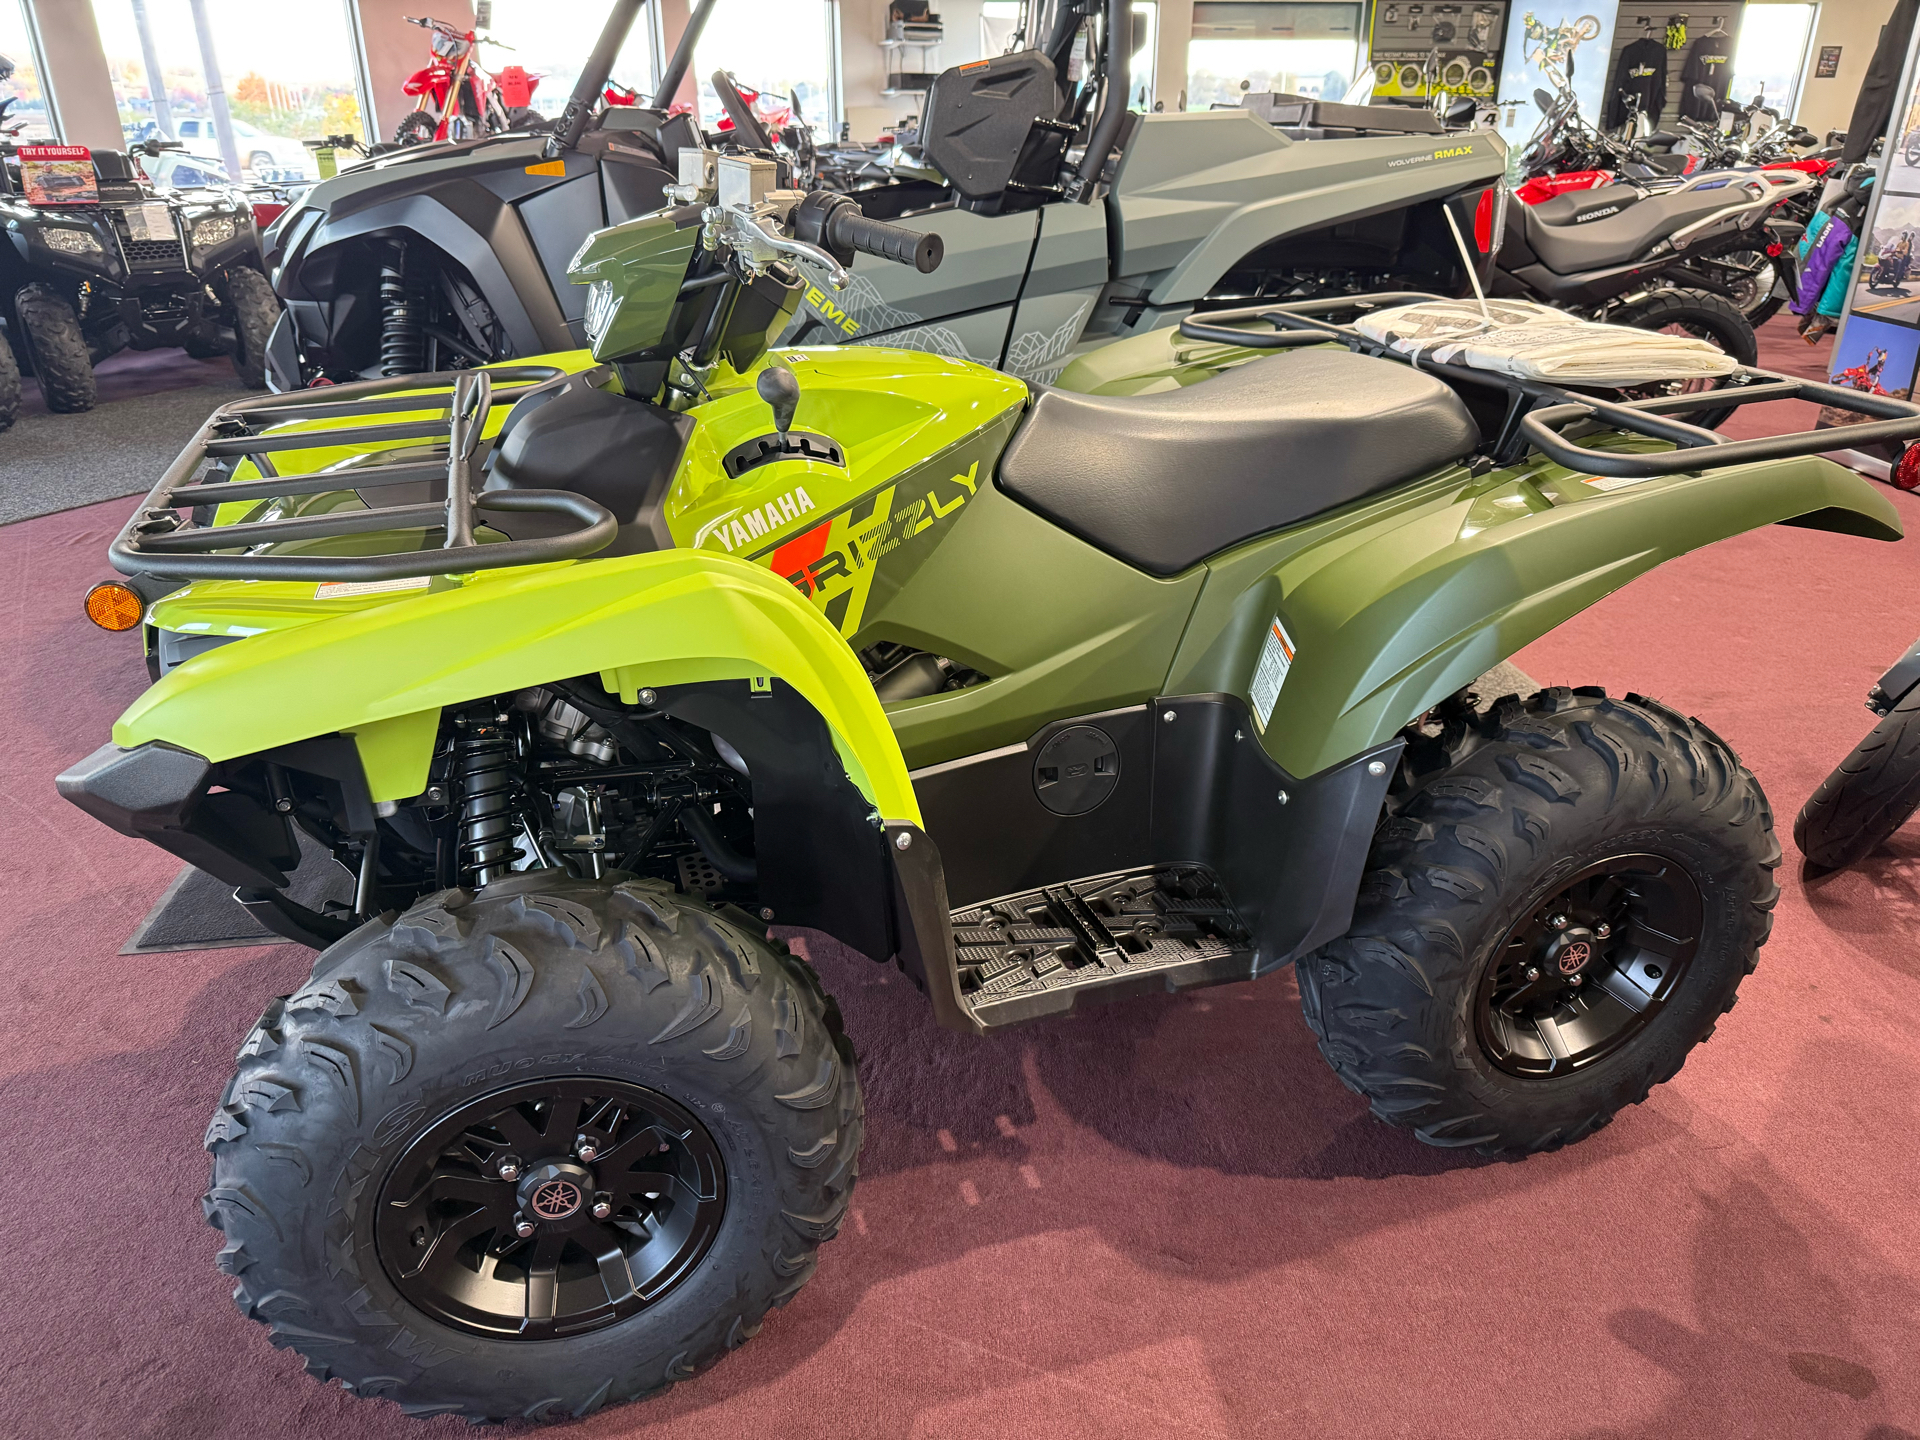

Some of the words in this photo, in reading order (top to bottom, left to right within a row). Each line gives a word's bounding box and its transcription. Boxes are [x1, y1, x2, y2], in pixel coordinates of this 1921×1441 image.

[1483, 113, 1497, 126] 4
[21, 147, 37, 156] TRY
[37, 147, 45, 156] IT
[46, 147, 85, 156] YOURSELF
[1388, 154, 1433, 168] WOLVERINE
[1434, 145, 1473, 160] RMAX
[1576, 205, 1620, 223] HONDA
[712, 486, 816, 552] YAMAHA
